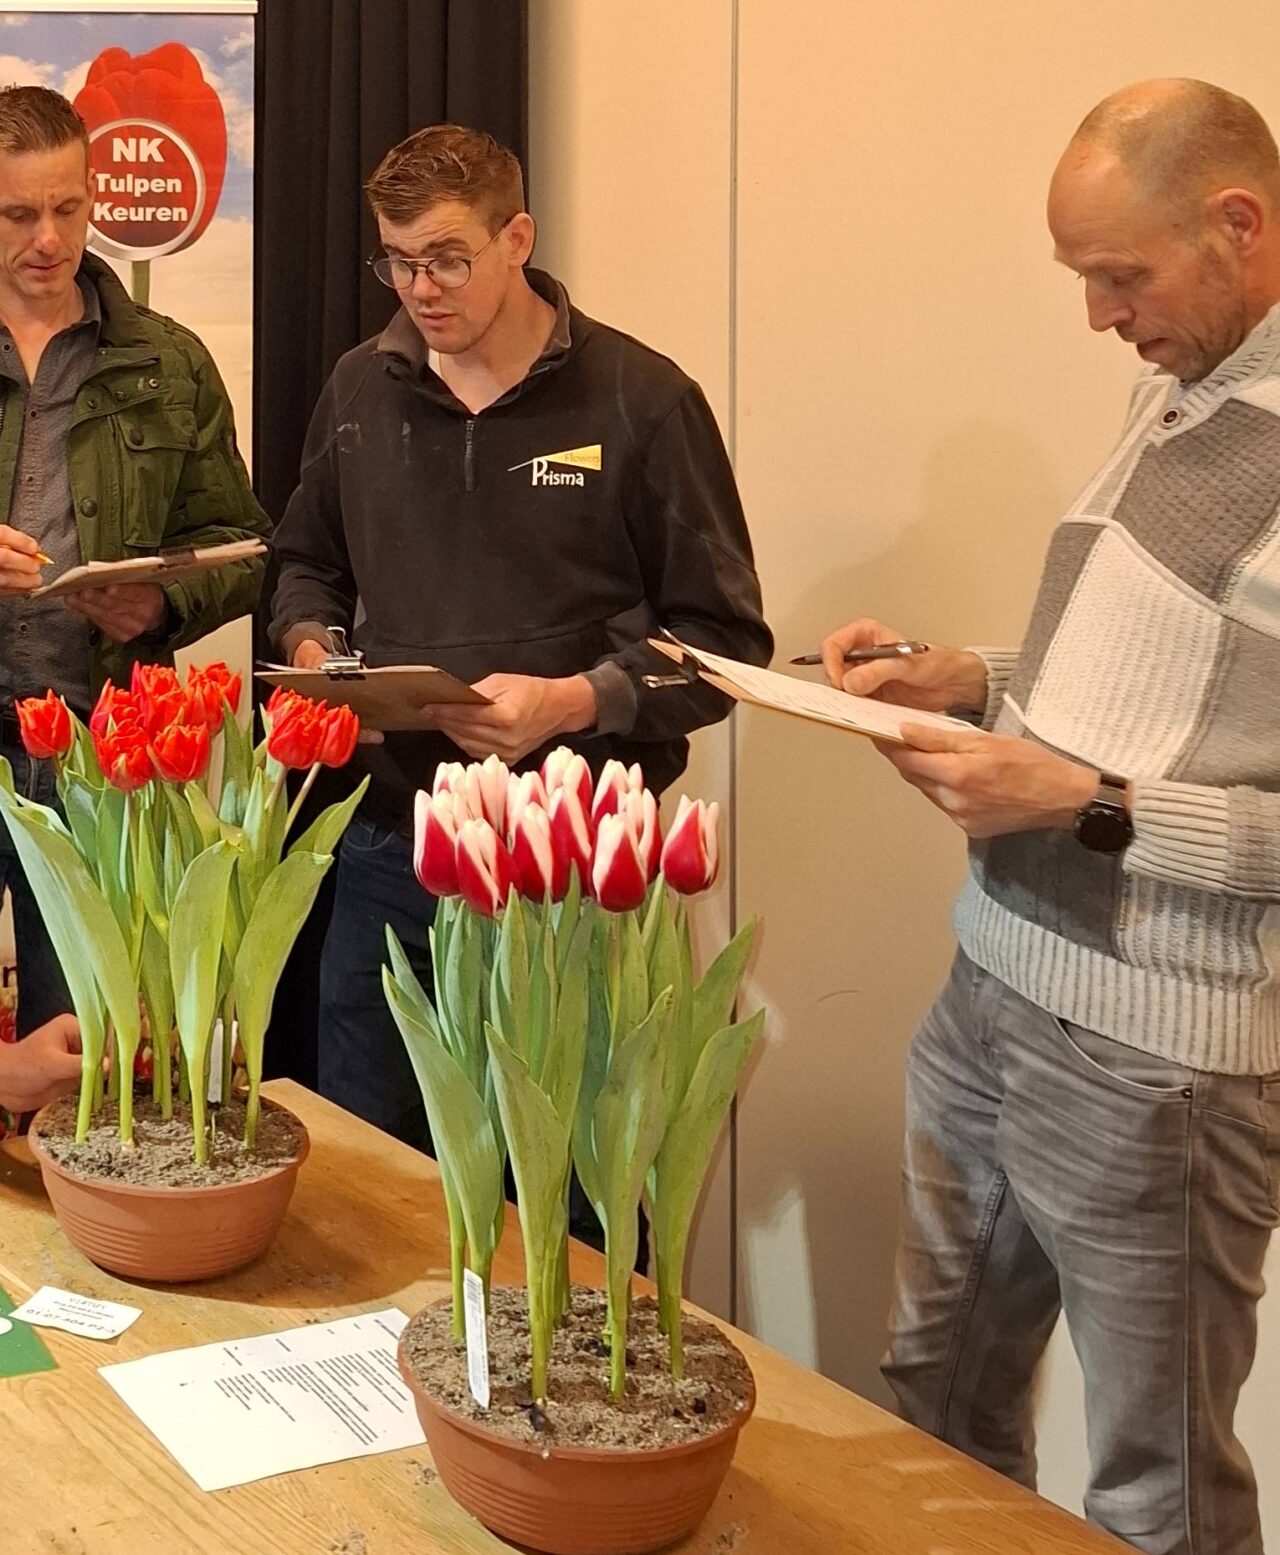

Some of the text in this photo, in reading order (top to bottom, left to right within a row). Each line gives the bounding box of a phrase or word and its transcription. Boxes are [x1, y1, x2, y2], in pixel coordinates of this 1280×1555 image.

[112, 137, 165, 164] NK
[96, 173, 183, 196] Tulpen
[93, 202, 188, 224] Keuren
[531, 460, 584, 487] Prisma
